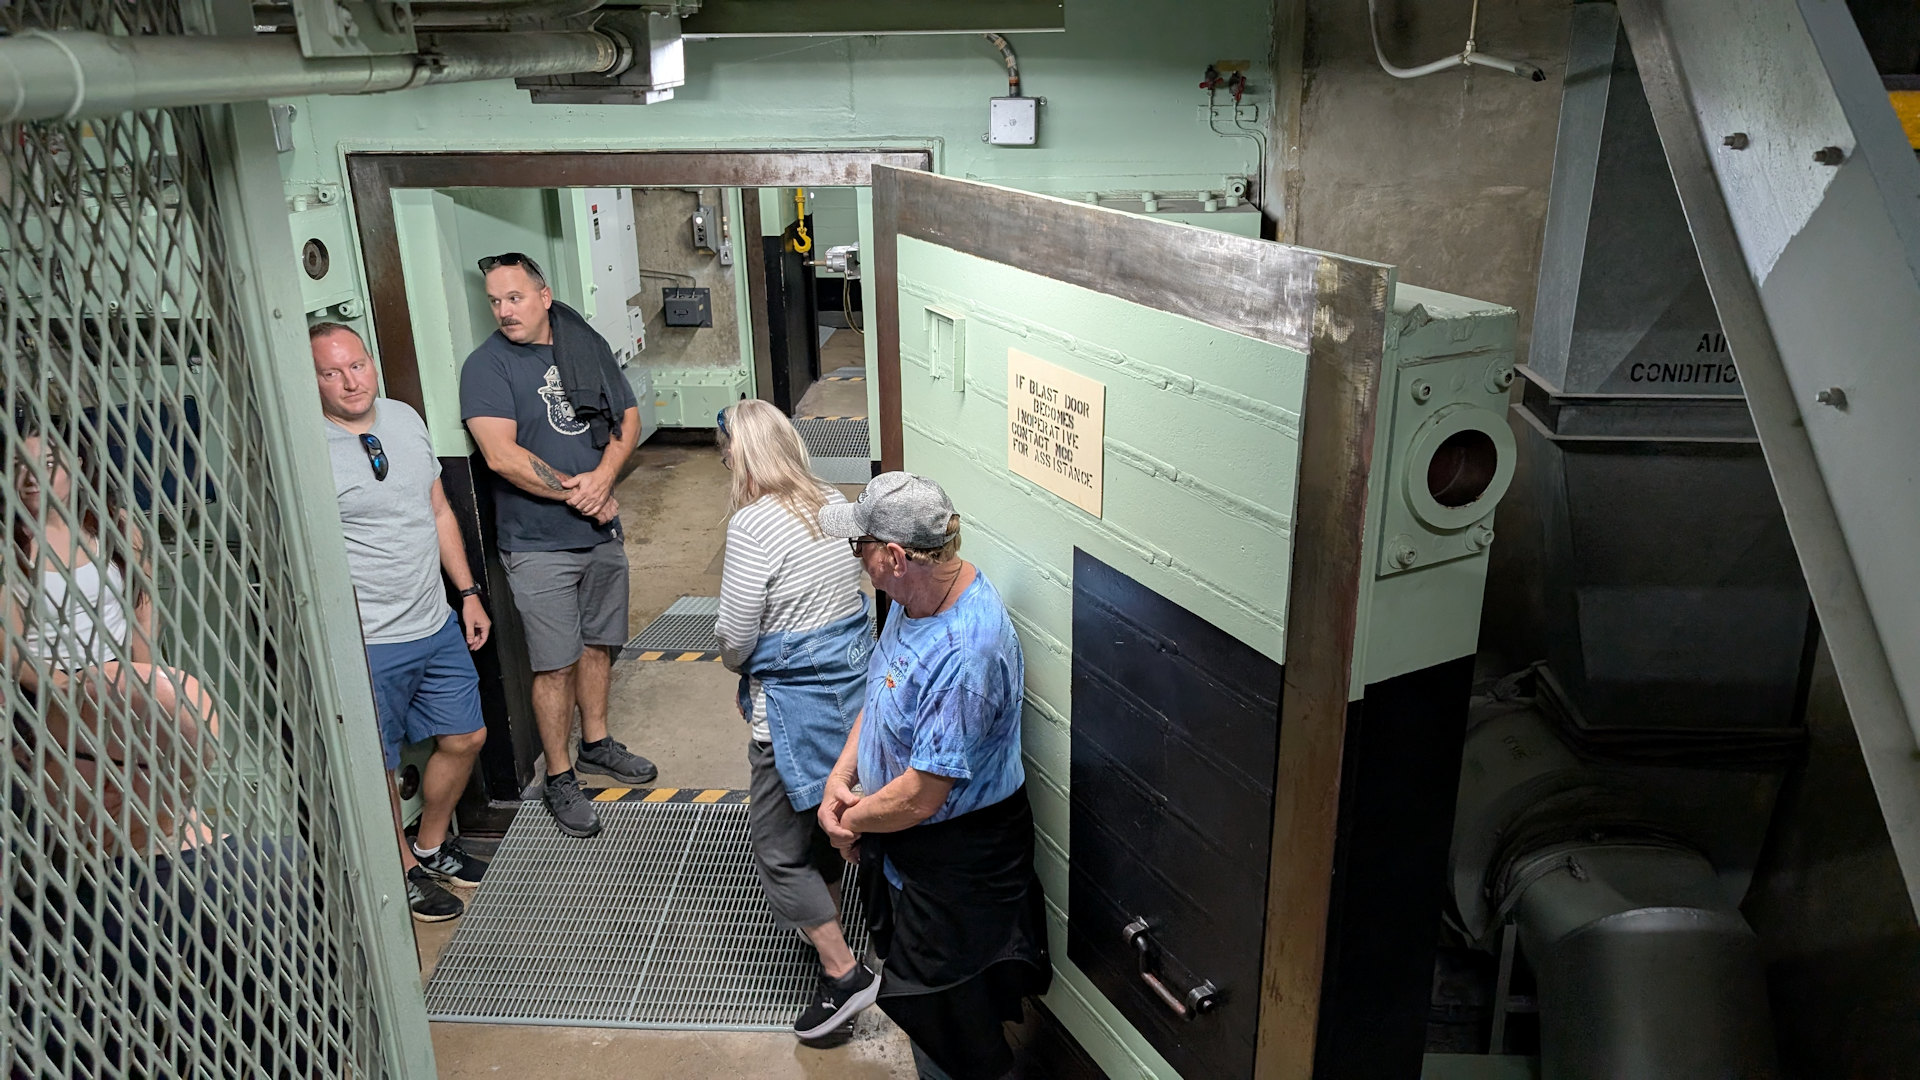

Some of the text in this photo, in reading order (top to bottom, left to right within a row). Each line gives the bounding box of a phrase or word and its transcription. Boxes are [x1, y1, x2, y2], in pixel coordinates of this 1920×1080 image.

[1630, 363, 1740, 383] CONDITIO
[1015, 373, 1090, 419] IF BLAST DOOR
[1033, 399, 1074, 430] BECOMES
[1011, 422, 1074, 463] CONTACT MCC
[1017, 407, 1079, 450] INOPERATIVE
[1012, 437, 1093, 489] FOR ASSISTANCE
